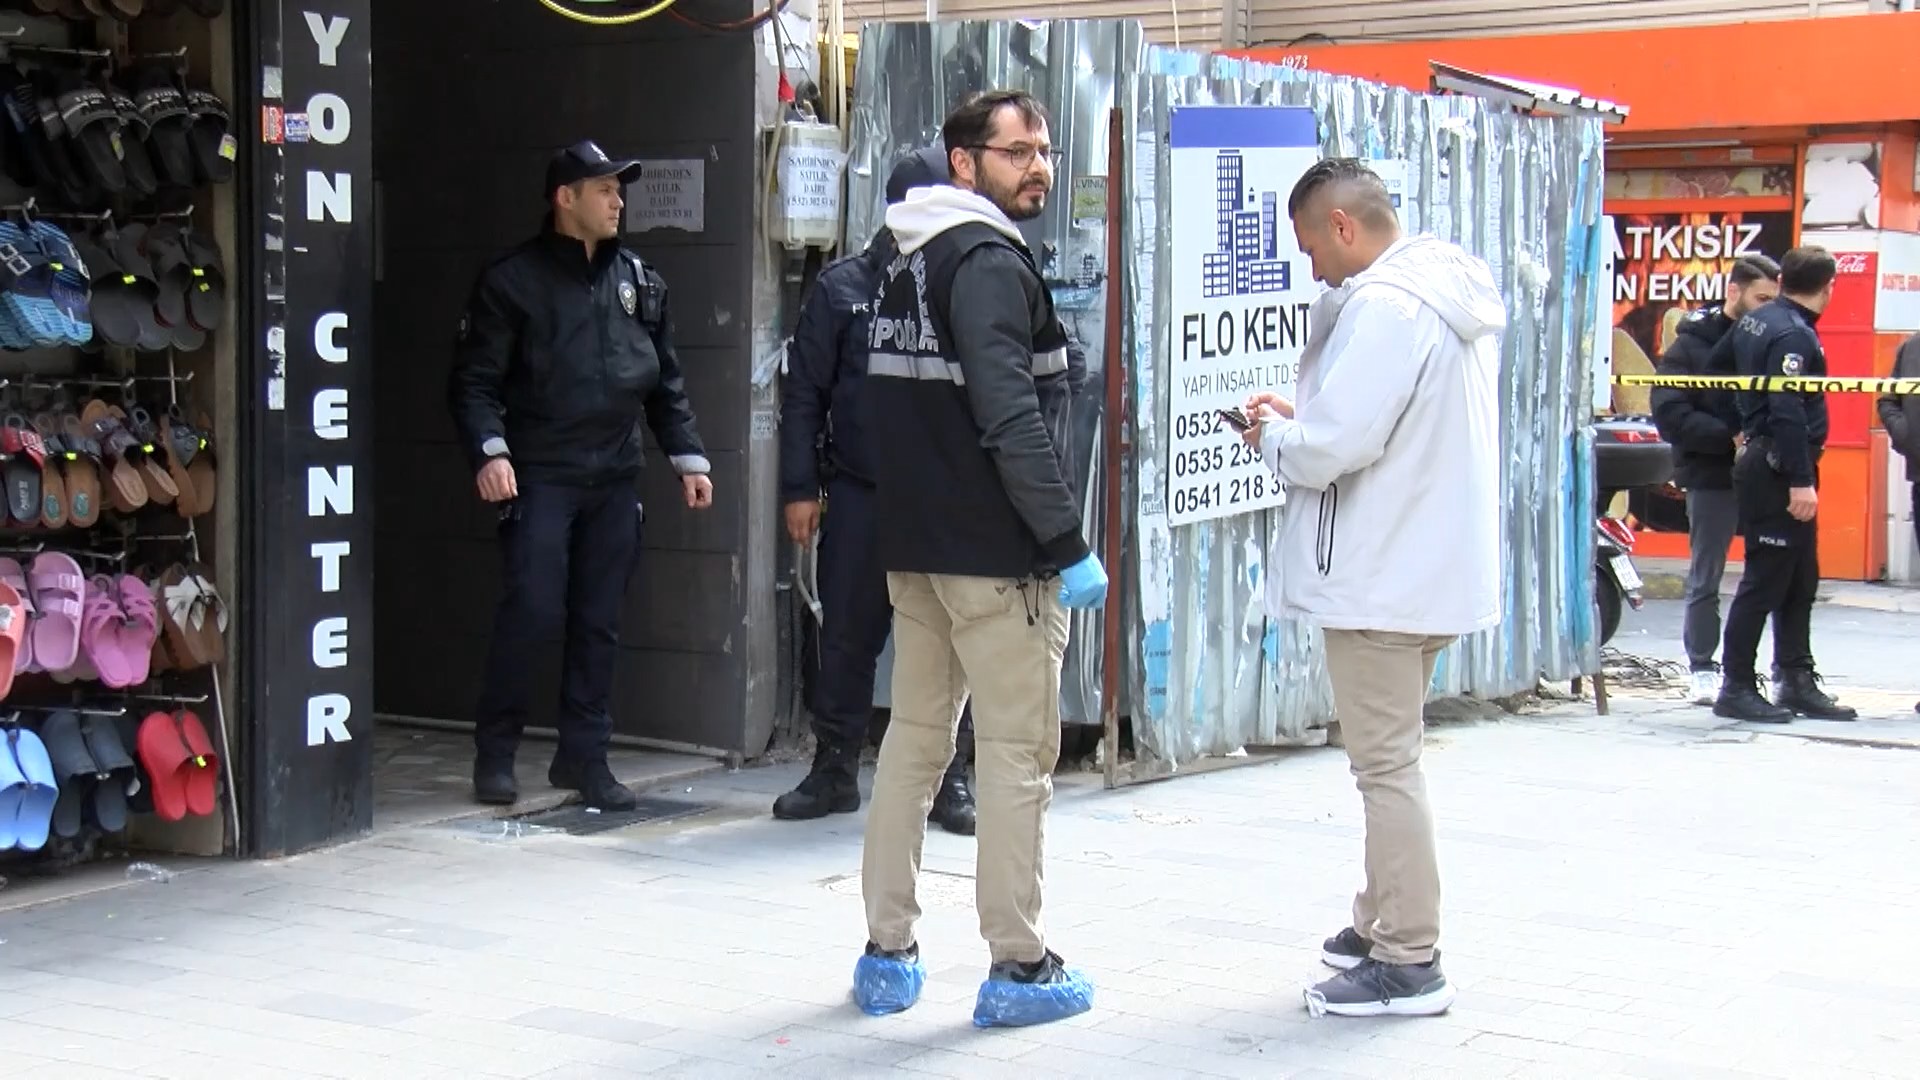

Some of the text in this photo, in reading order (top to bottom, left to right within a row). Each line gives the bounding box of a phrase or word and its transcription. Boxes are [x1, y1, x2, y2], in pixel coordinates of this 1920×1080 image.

[1281, 54, 1309, 70] 1973
[1183, 303, 1310, 361] FLO KENT
[303, 11, 354, 747] YON CENTER
[1182, 375, 1213, 399] YAPI
[1216, 367, 1263, 393] İNŞAAT
[1176, 409, 1223, 440] 0532
[1175, 445, 1223, 478] 0535
[1174, 482, 1220, 514] 0541
[1230, 474, 1264, 504] 218
